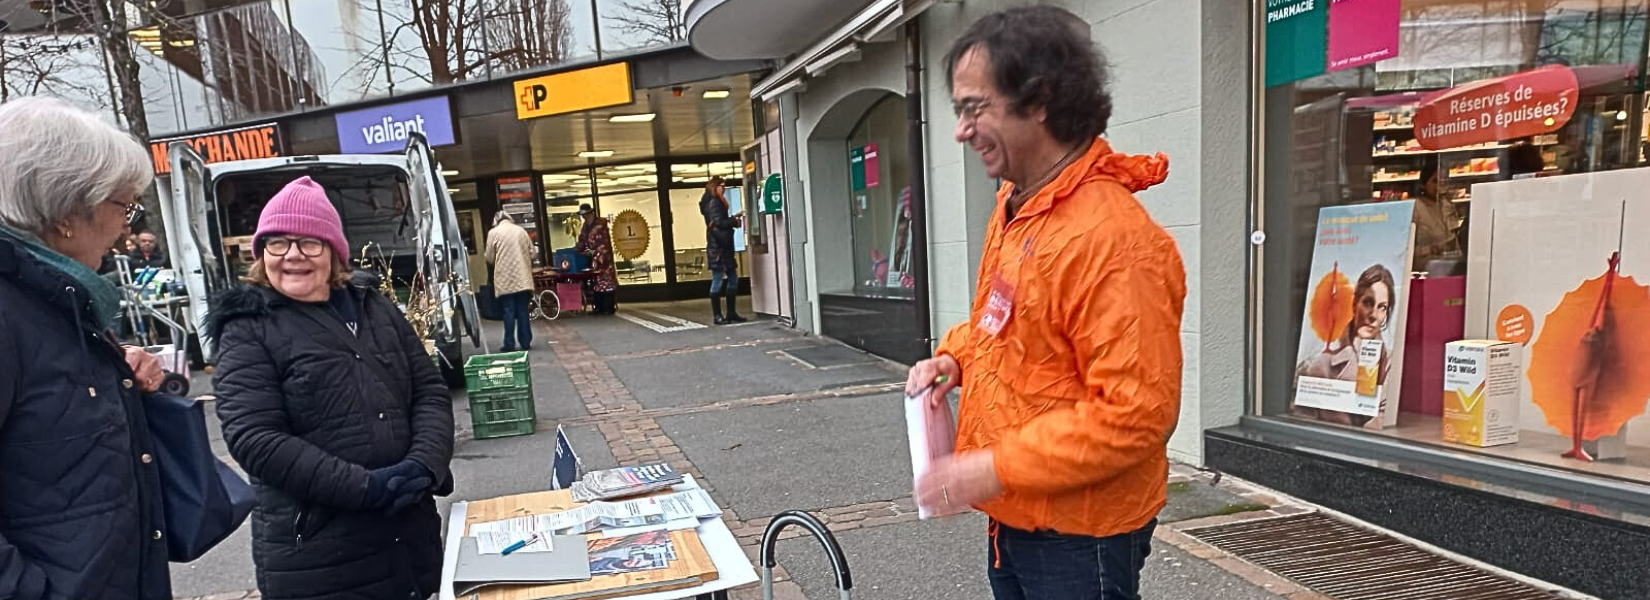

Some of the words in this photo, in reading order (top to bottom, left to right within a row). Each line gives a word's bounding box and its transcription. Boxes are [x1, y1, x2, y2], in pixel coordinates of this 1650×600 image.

[1268, 0, 1314, 23] PHARMACIE
[1451, 92, 1510, 115] Réserves
[1514, 85, 1533, 101] de
[362, 114, 426, 145] valiant
[1421, 112, 1477, 139] vitamine
[1480, 113, 1491, 128] D
[1495, 98, 1568, 128] épuisées?
[151, 127, 279, 174] MCHANDE
[1447, 355, 1477, 366] Vitamin
[1447, 364, 1458, 373] D3
[1459, 365, 1477, 375] Wild
